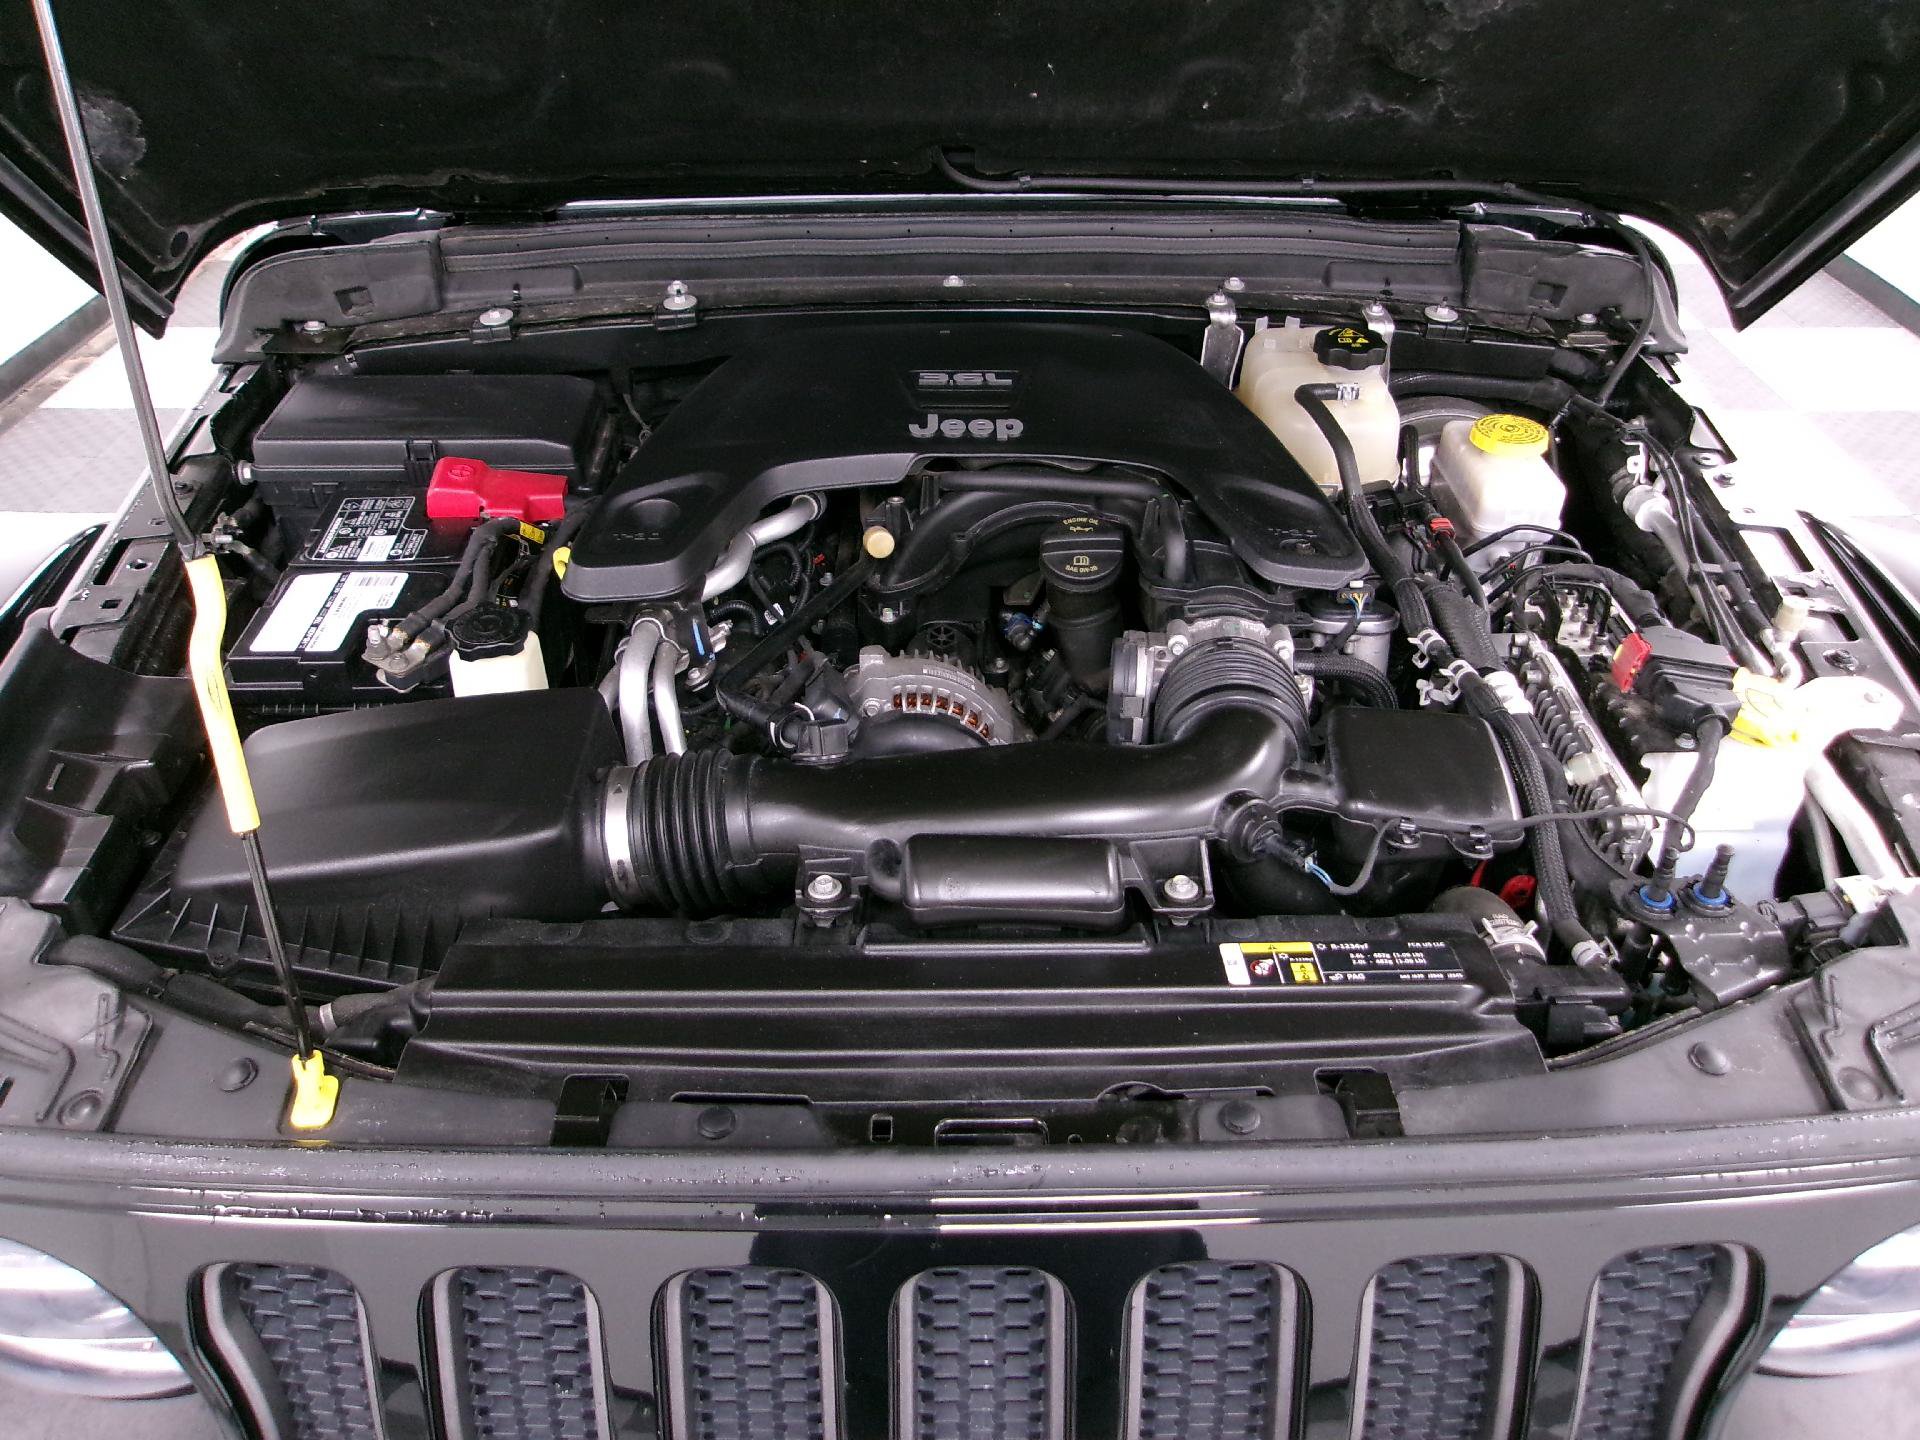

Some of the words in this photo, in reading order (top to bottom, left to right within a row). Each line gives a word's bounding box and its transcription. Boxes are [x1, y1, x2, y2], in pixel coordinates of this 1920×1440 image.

[918, 372, 1013, 386] 3.6L
[908, 413, 1024, 441] Jeep
[1062, 517, 1088, 525] ENGINE
[1065, 565, 1079, 573] SAE
